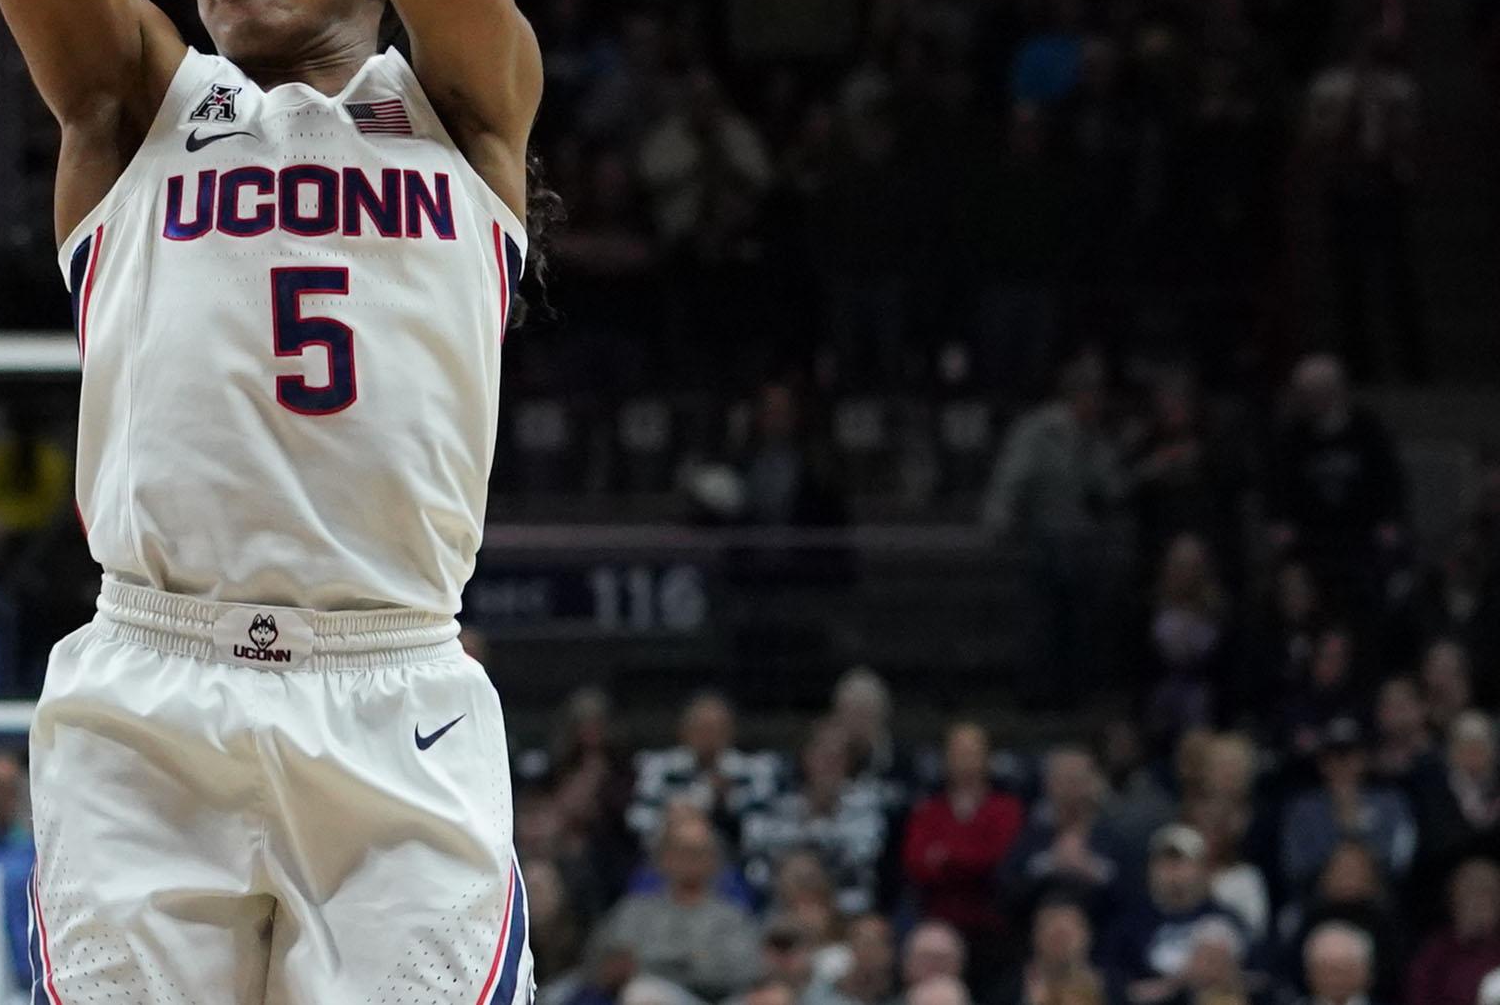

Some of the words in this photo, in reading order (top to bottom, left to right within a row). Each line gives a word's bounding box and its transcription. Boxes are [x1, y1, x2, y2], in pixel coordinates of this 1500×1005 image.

[163, 164, 457, 242] UCONN
[271, 266, 358, 416] 5
[233, 644, 291, 663] UCONN
